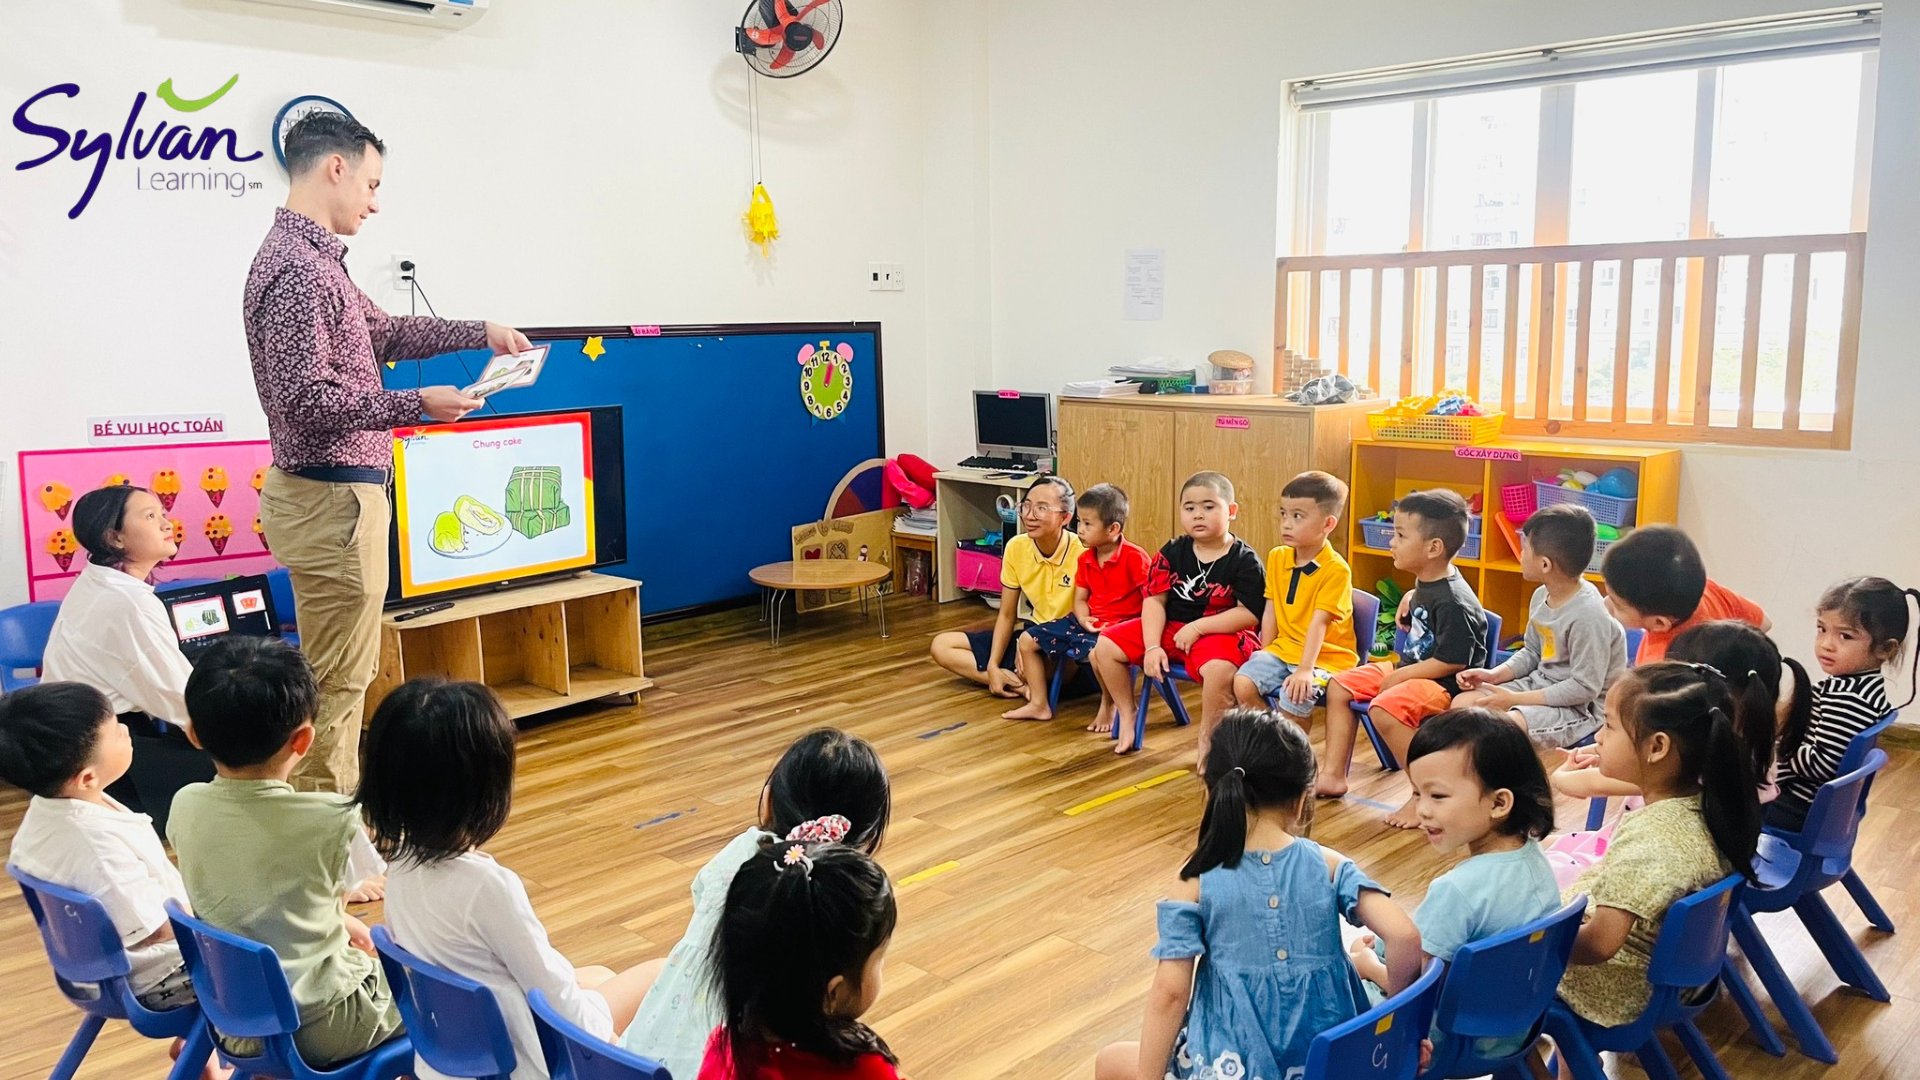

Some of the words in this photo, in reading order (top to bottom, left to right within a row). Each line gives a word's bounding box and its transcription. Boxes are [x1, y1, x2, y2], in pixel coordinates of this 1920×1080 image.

[811, 356, 818, 367] 11
[821, 352, 830, 362] 12
[834, 355, 838, 364] 1
[804, 367, 813, 377] 10
[841, 364, 847, 374] 2
[804, 381, 810, 391] 9
[845, 376, 851, 386] 3
[807, 395, 813, 405] 8
[843, 391, 848, 400] 4
[814, 405, 821, 414] 7
[836, 402, 843, 412] 5
[826, 408, 832, 417] 6
[94, 420, 113, 436] BÉ
[117, 422, 143, 435] VUI
[147, 421, 180, 436] HỌC
[184, 417, 224, 433] TOÁN
[472, 440, 501, 449] Chung
[503, 437, 522, 446] cake
